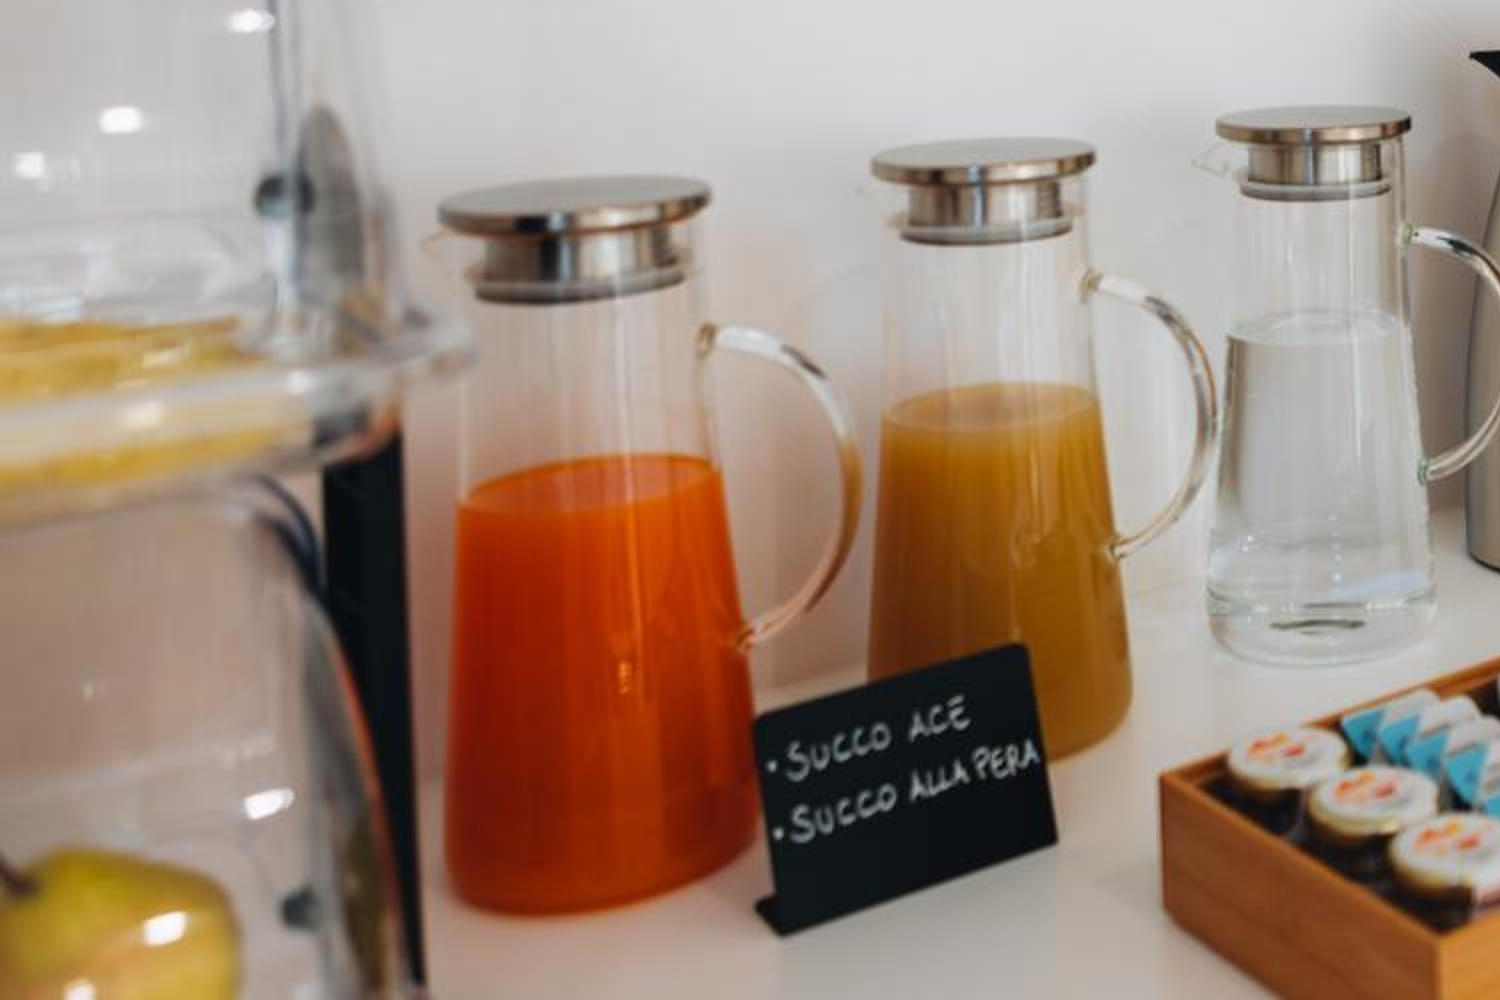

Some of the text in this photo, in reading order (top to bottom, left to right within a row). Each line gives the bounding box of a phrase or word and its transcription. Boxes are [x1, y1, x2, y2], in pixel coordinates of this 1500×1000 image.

[786, 694, 972, 782] SUCCO ACE
[789, 740, 1040, 844] SUCCO ALLA PERA
